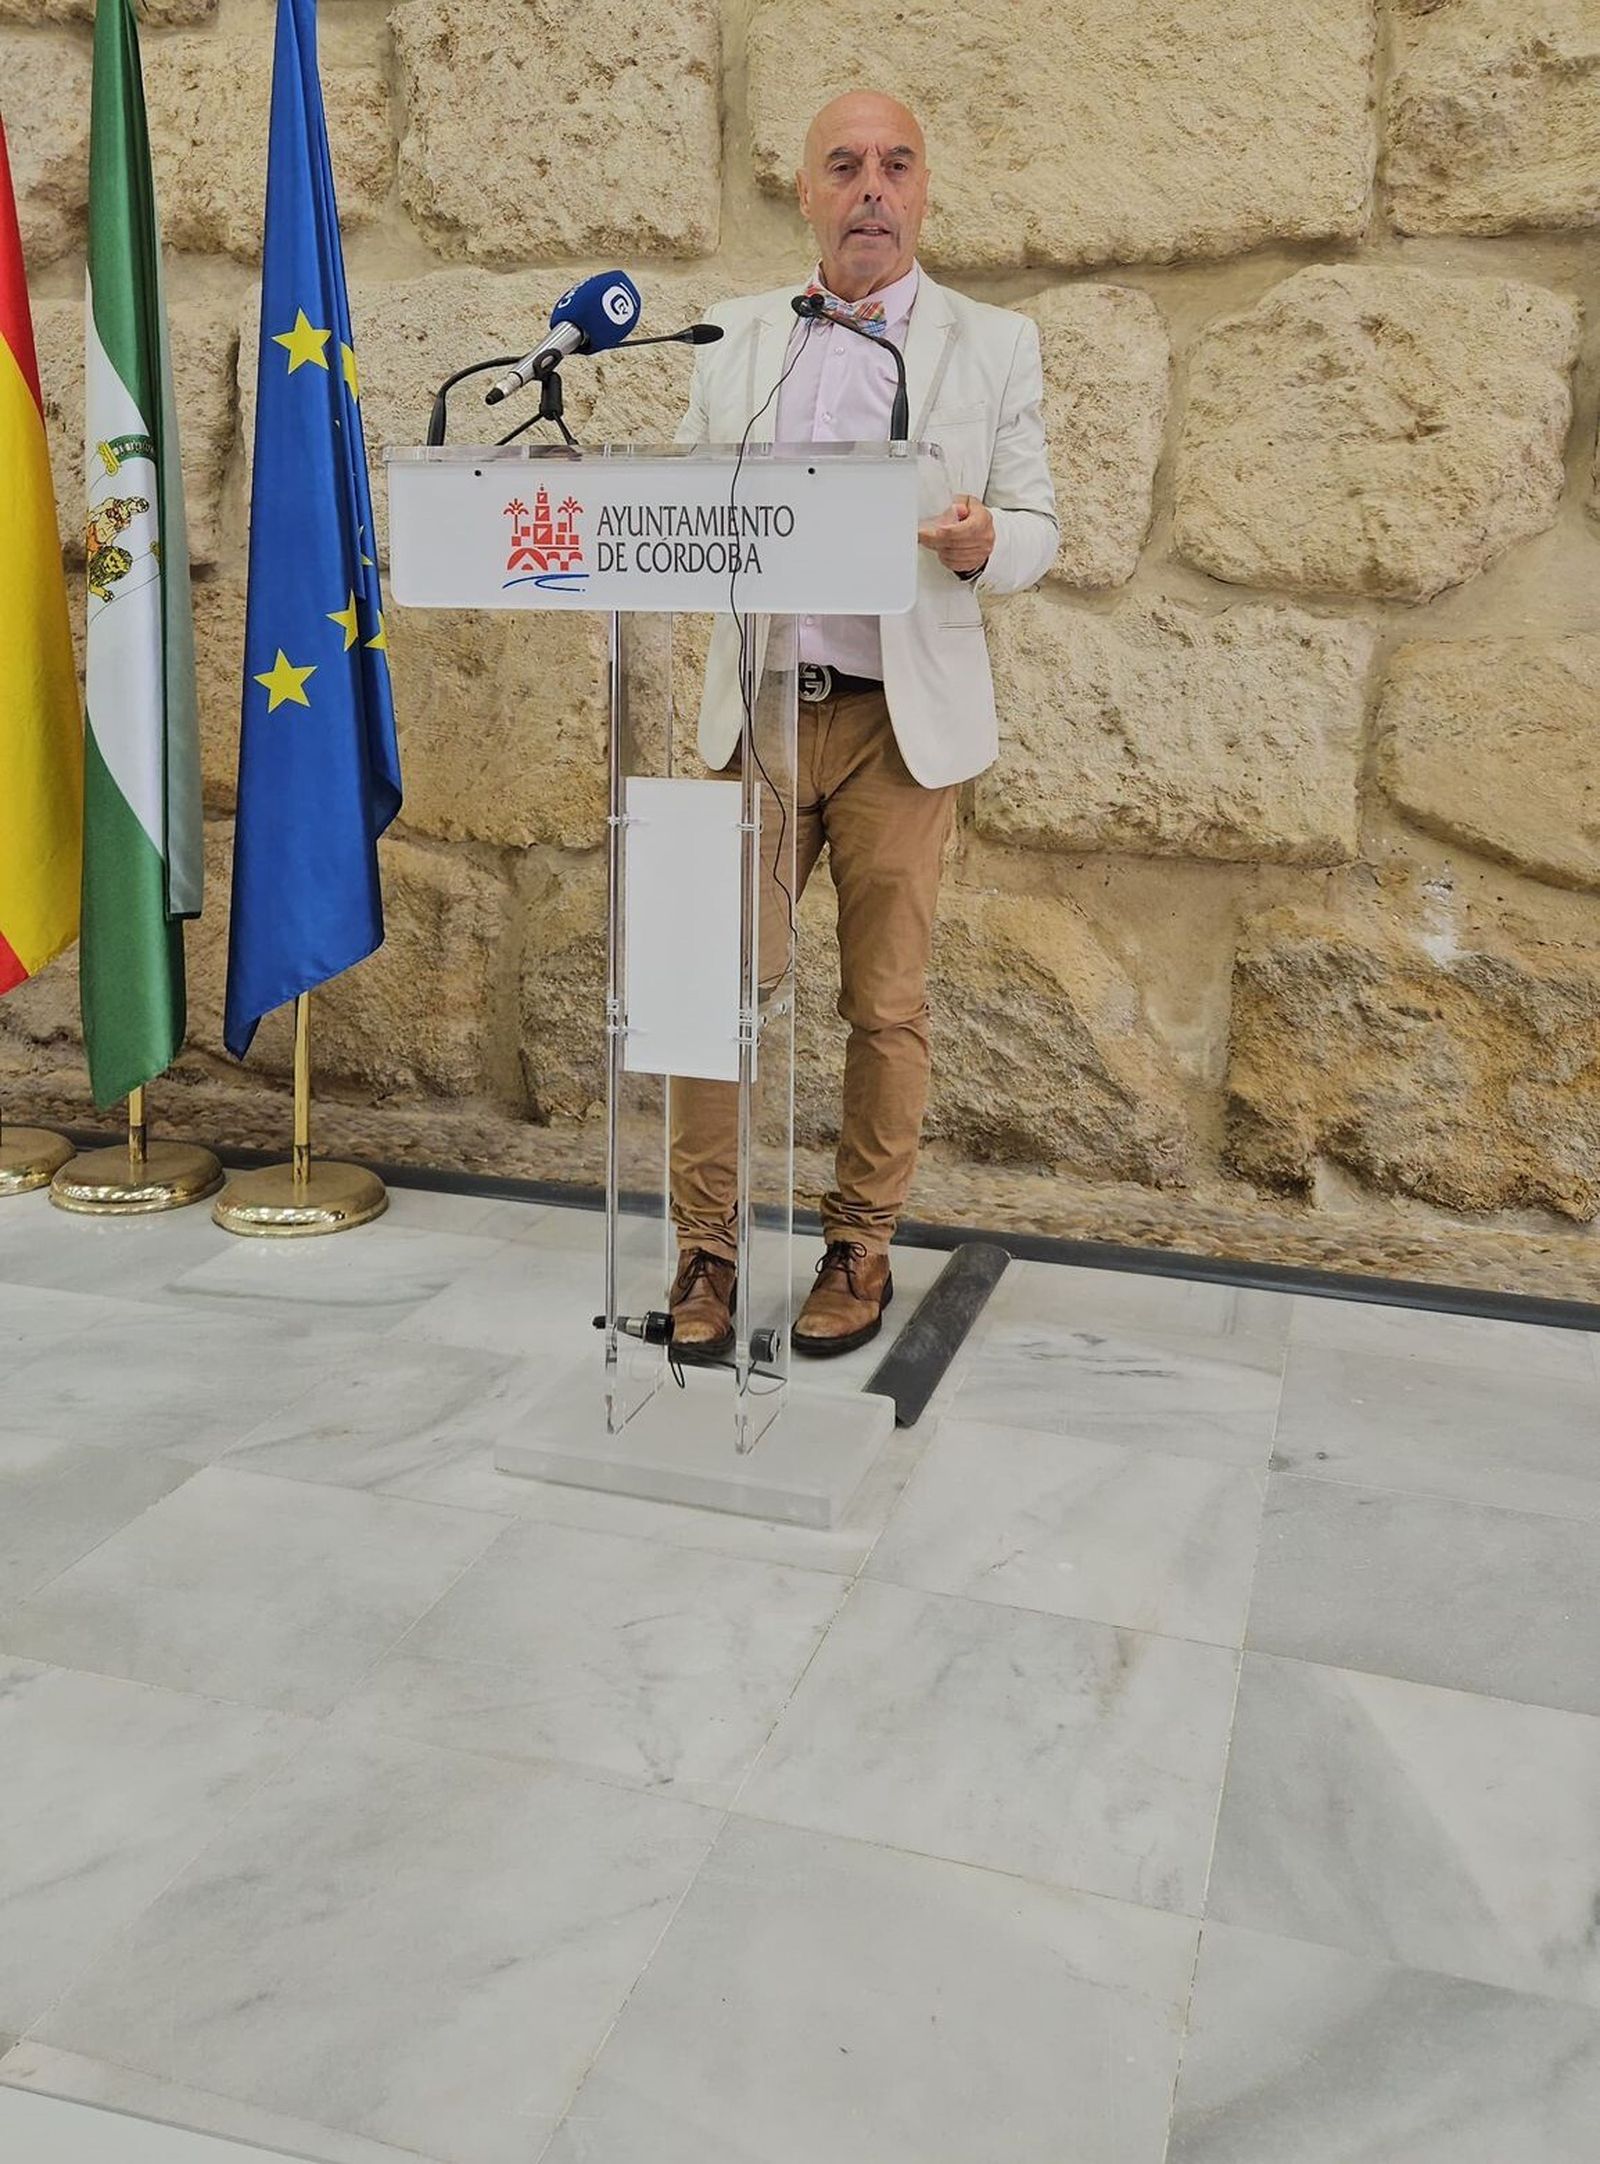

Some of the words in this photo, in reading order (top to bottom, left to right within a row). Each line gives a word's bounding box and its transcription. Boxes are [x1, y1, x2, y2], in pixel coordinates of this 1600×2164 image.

[596, 505, 795, 537] AYUNTAMIENTO
[597, 543, 628, 573] DE
[636, 538, 763, 574] CÓRDOBA
